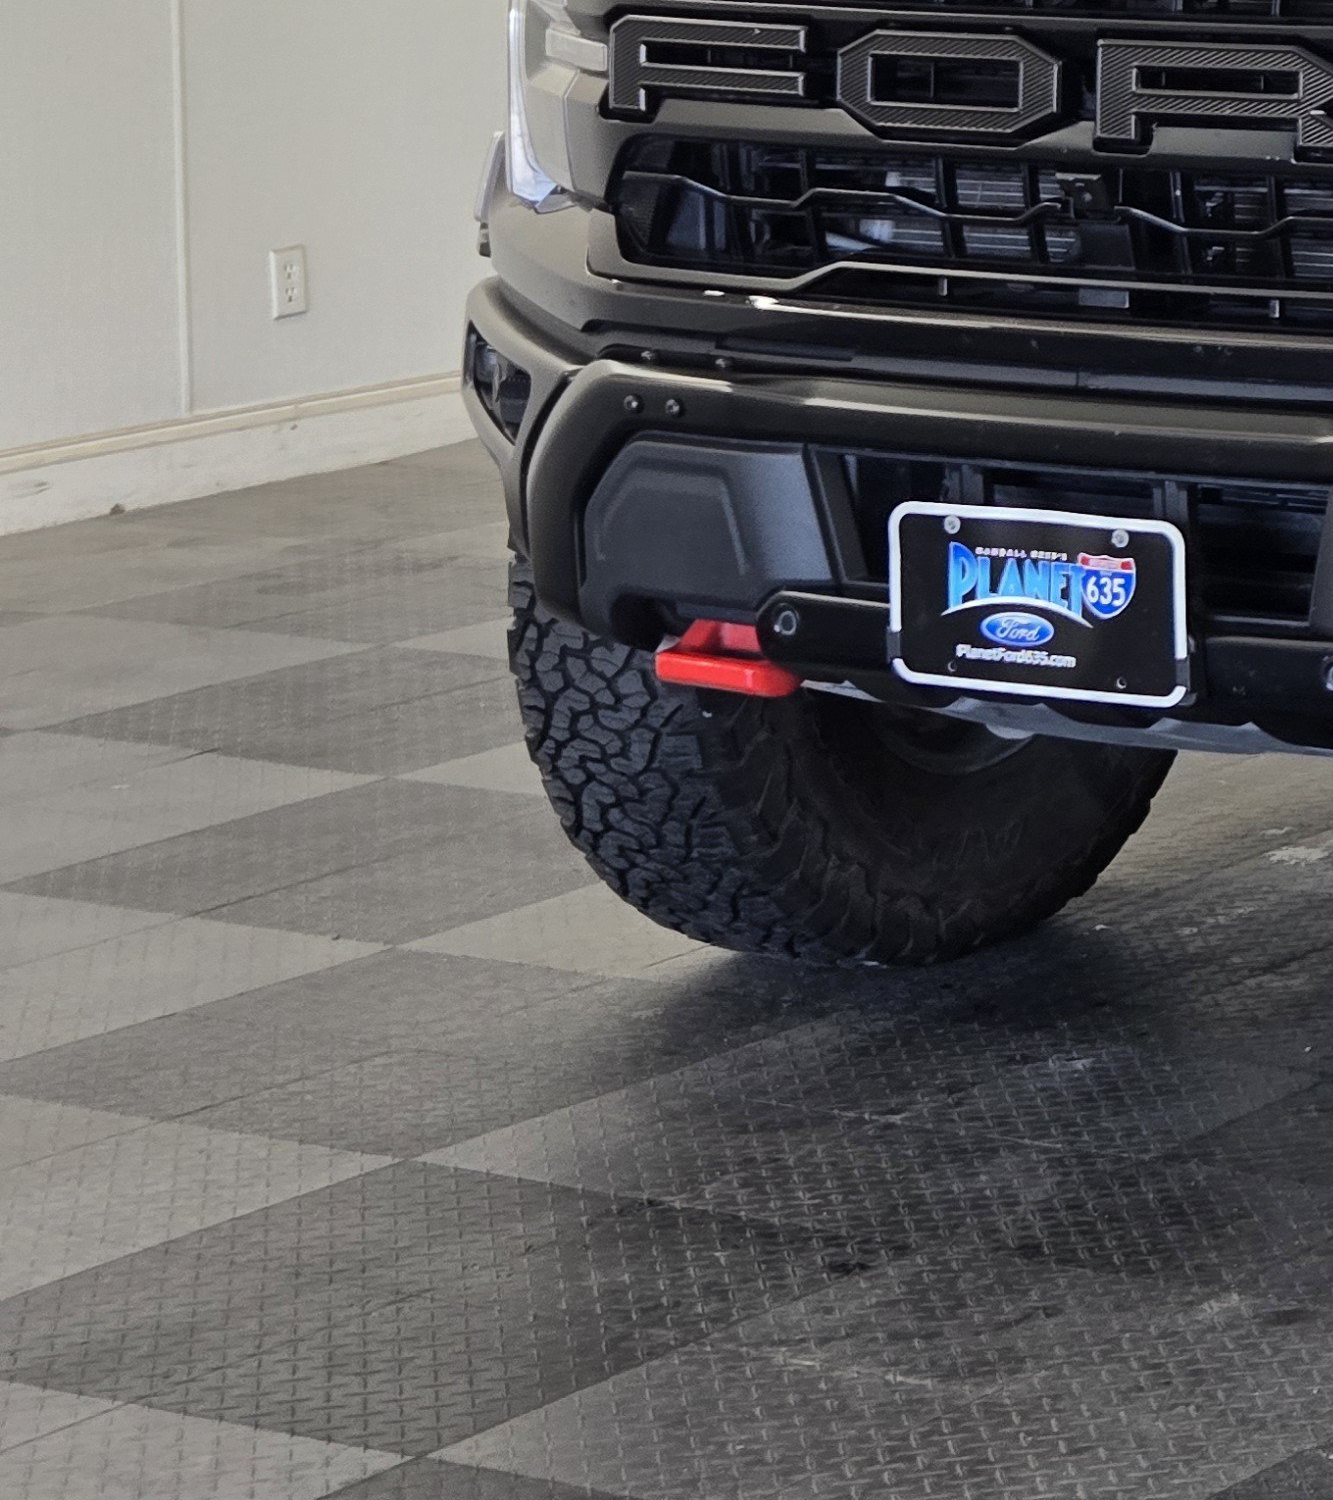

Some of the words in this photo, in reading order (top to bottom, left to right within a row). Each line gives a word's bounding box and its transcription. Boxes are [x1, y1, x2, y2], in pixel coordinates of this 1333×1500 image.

[948, 541, 1084, 618] PLANET
[1086, 576, 1126, 607] 635
[996, 617, 1040, 642] Ford
